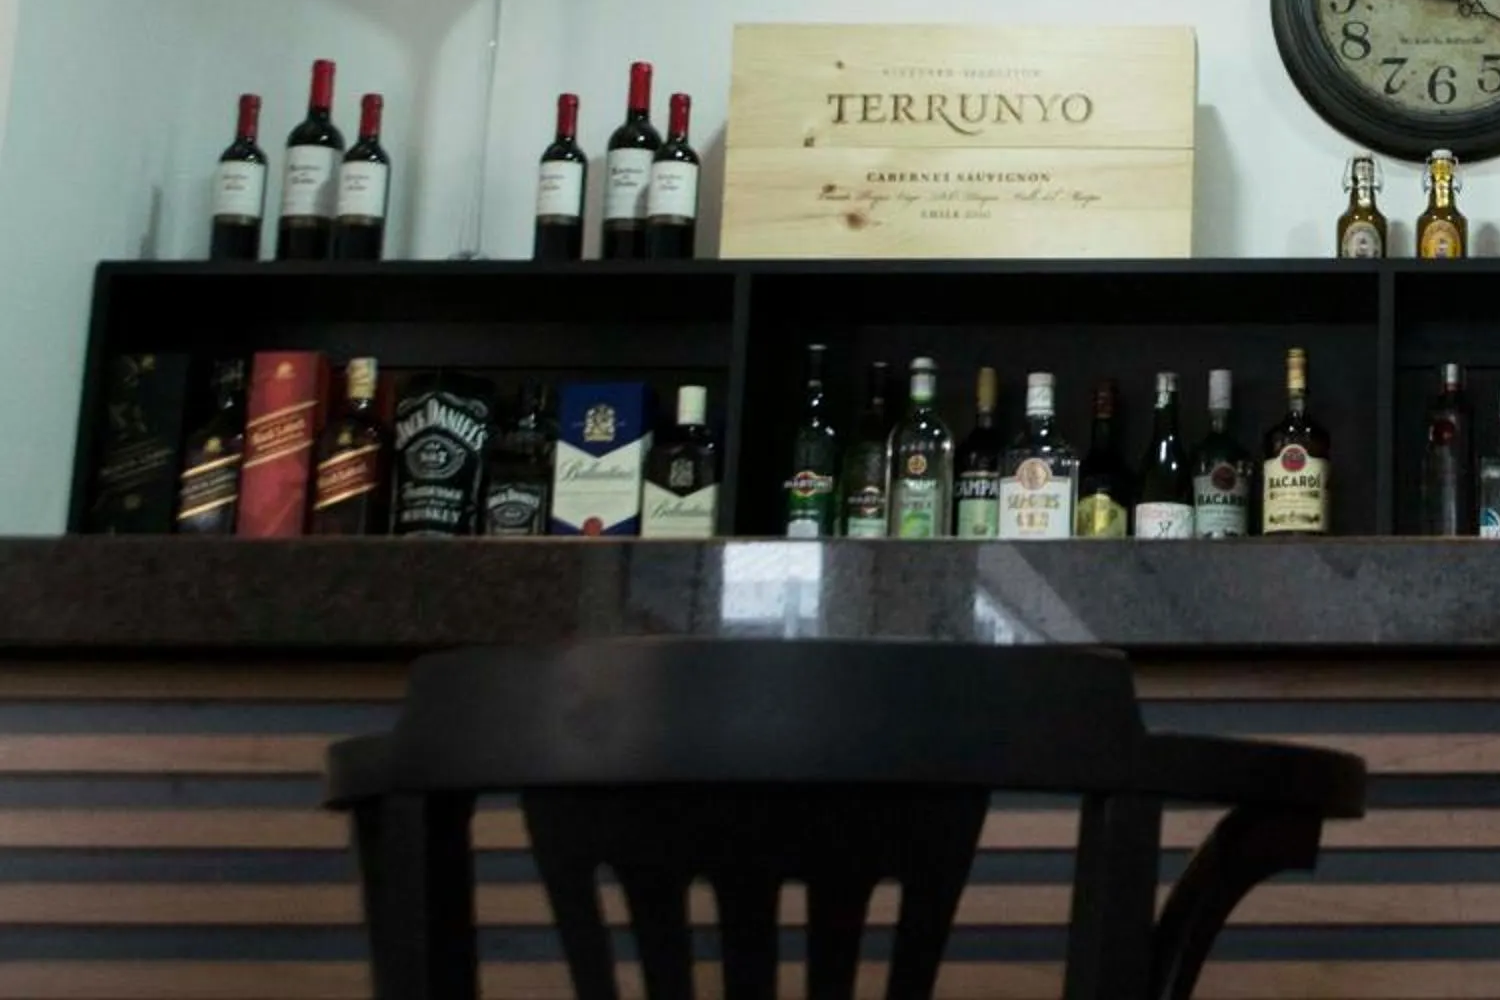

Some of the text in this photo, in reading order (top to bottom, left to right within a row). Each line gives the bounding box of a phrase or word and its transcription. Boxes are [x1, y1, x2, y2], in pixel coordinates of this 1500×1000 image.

[1341, 22, 1371, 61] 8
[1380, 57, 1408, 95] 7
[1427, 65, 1457, 105] 6
[827, 93, 1094, 136] TERRUNYO
[866, 172, 1051, 183] CABERNET SAUVIGNON
